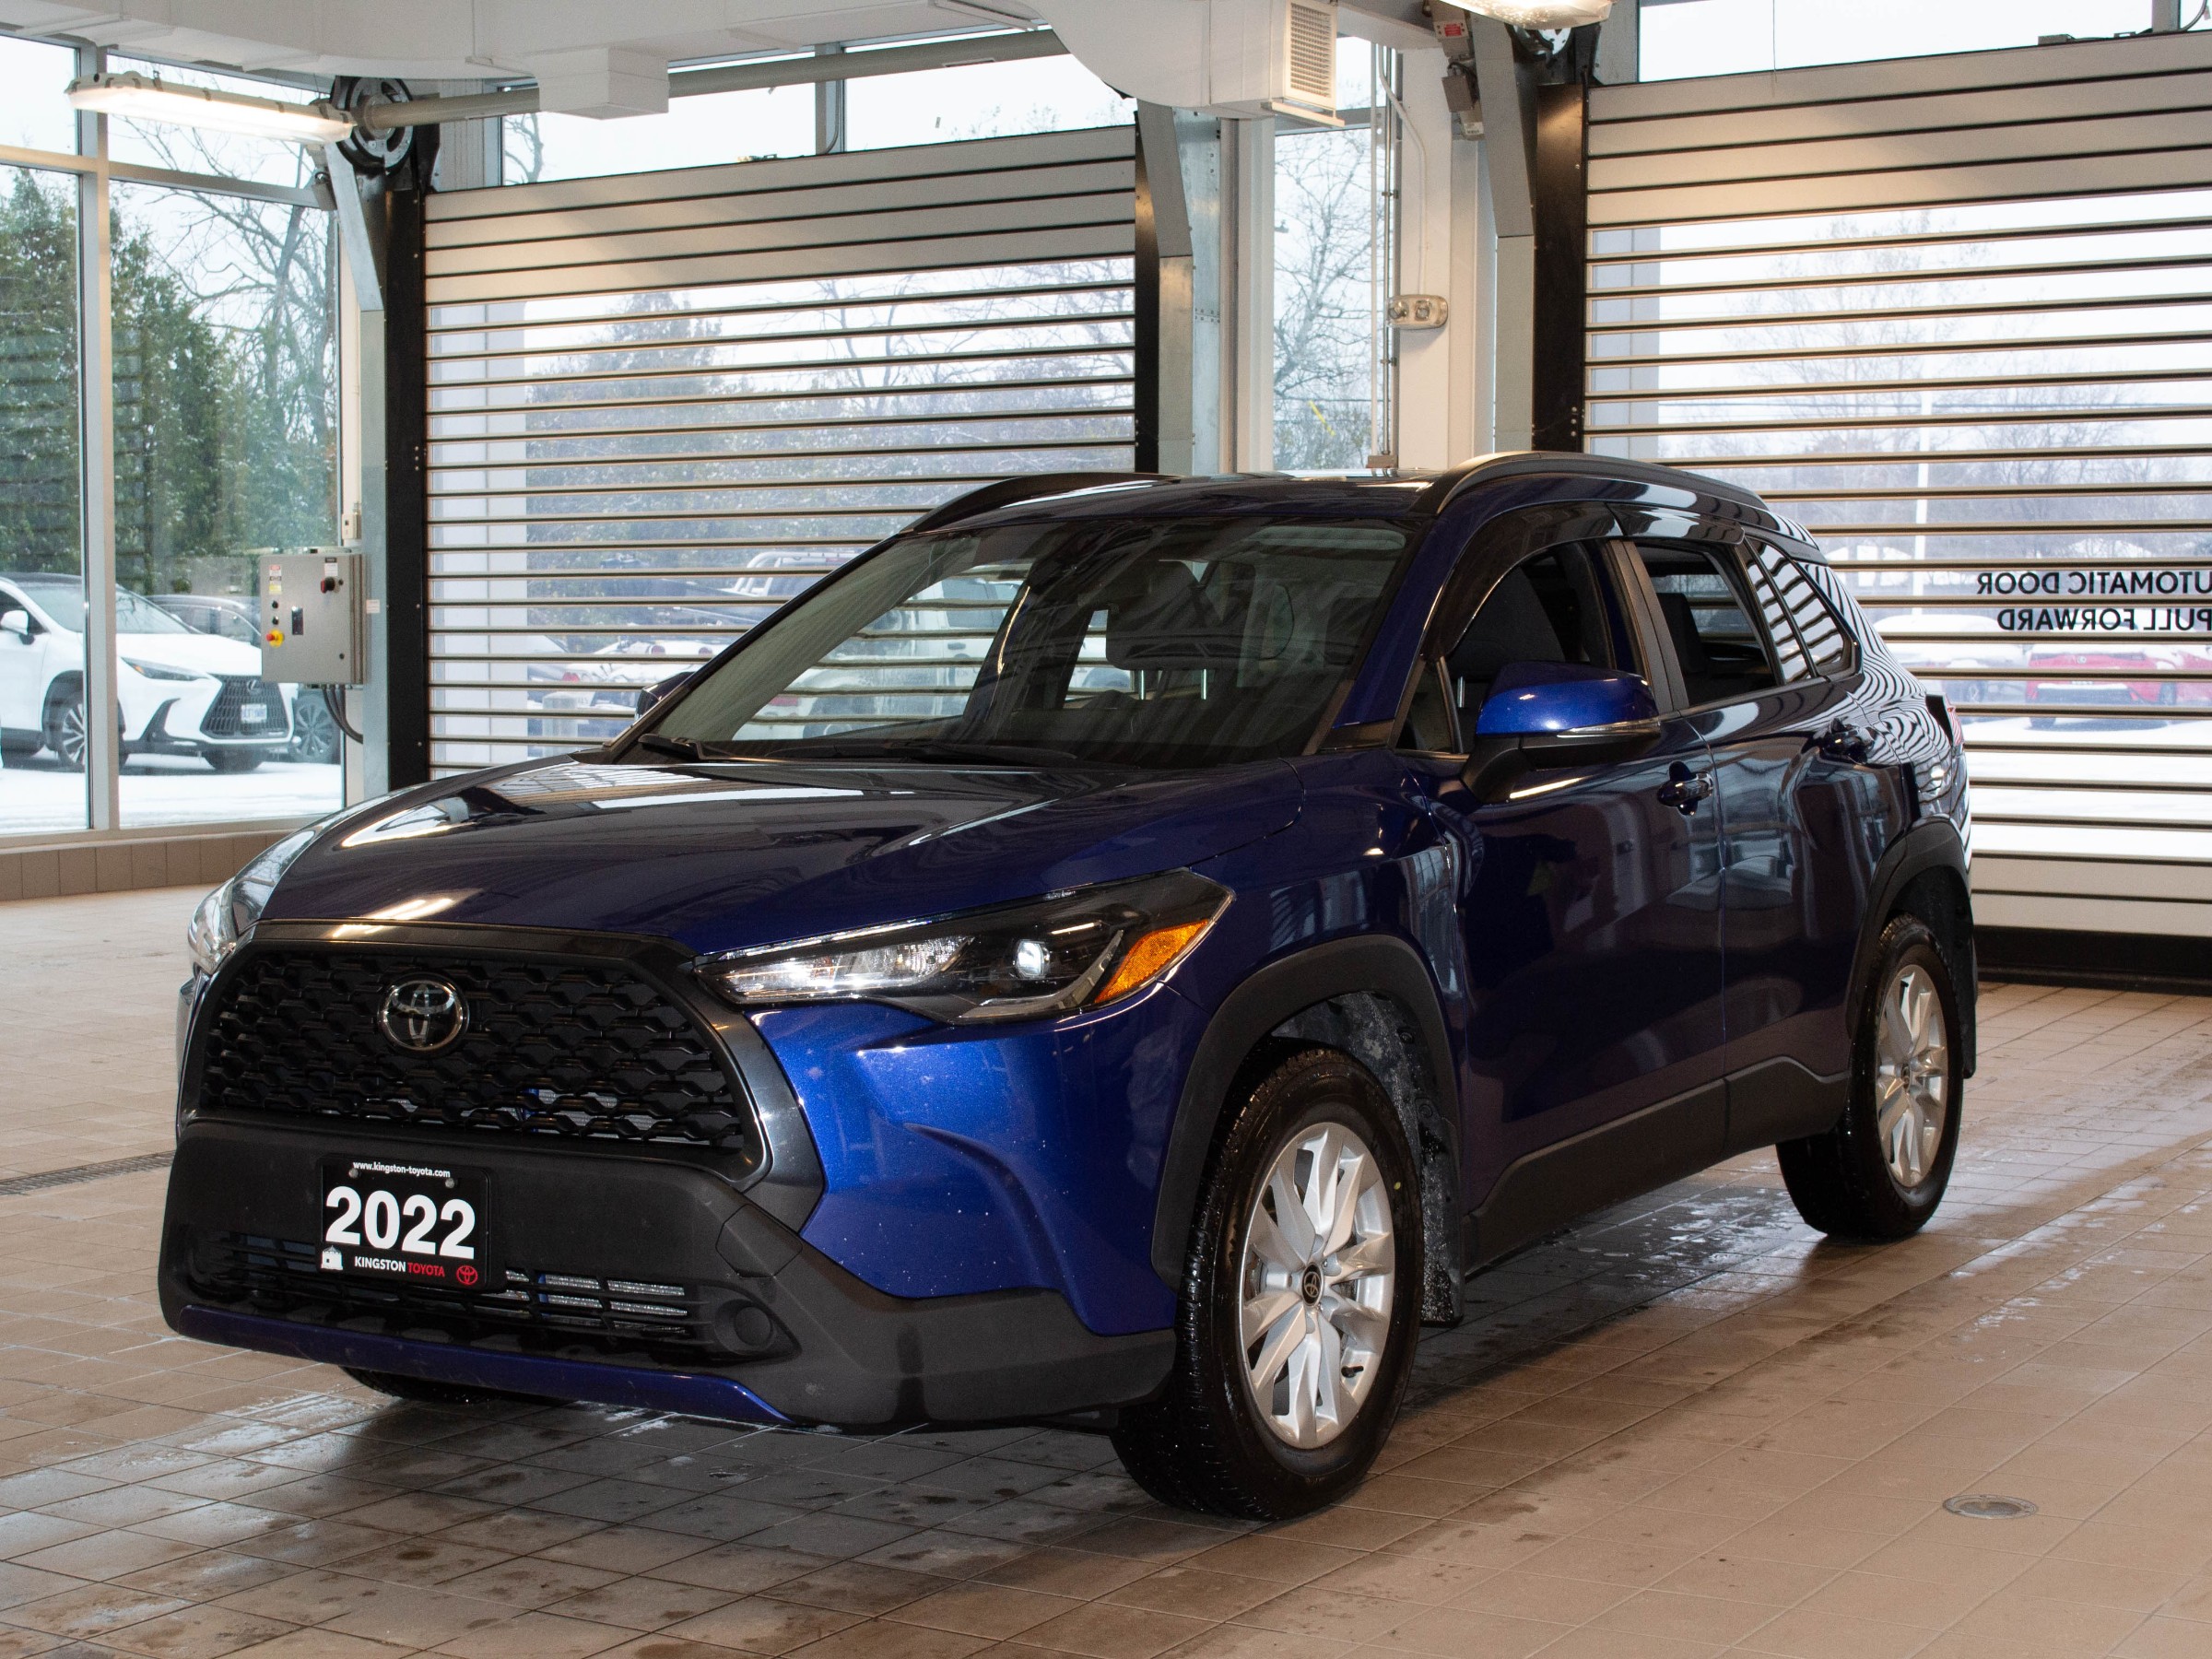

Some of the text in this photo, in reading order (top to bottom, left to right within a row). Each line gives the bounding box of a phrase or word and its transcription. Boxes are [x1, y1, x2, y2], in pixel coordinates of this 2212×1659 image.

[353, 1161, 451, 1177] www.kingston-toyota.com
[325, 1185, 476, 1259] 2022
[354, 1255, 445, 1277] KINGSTON TOYOTA
